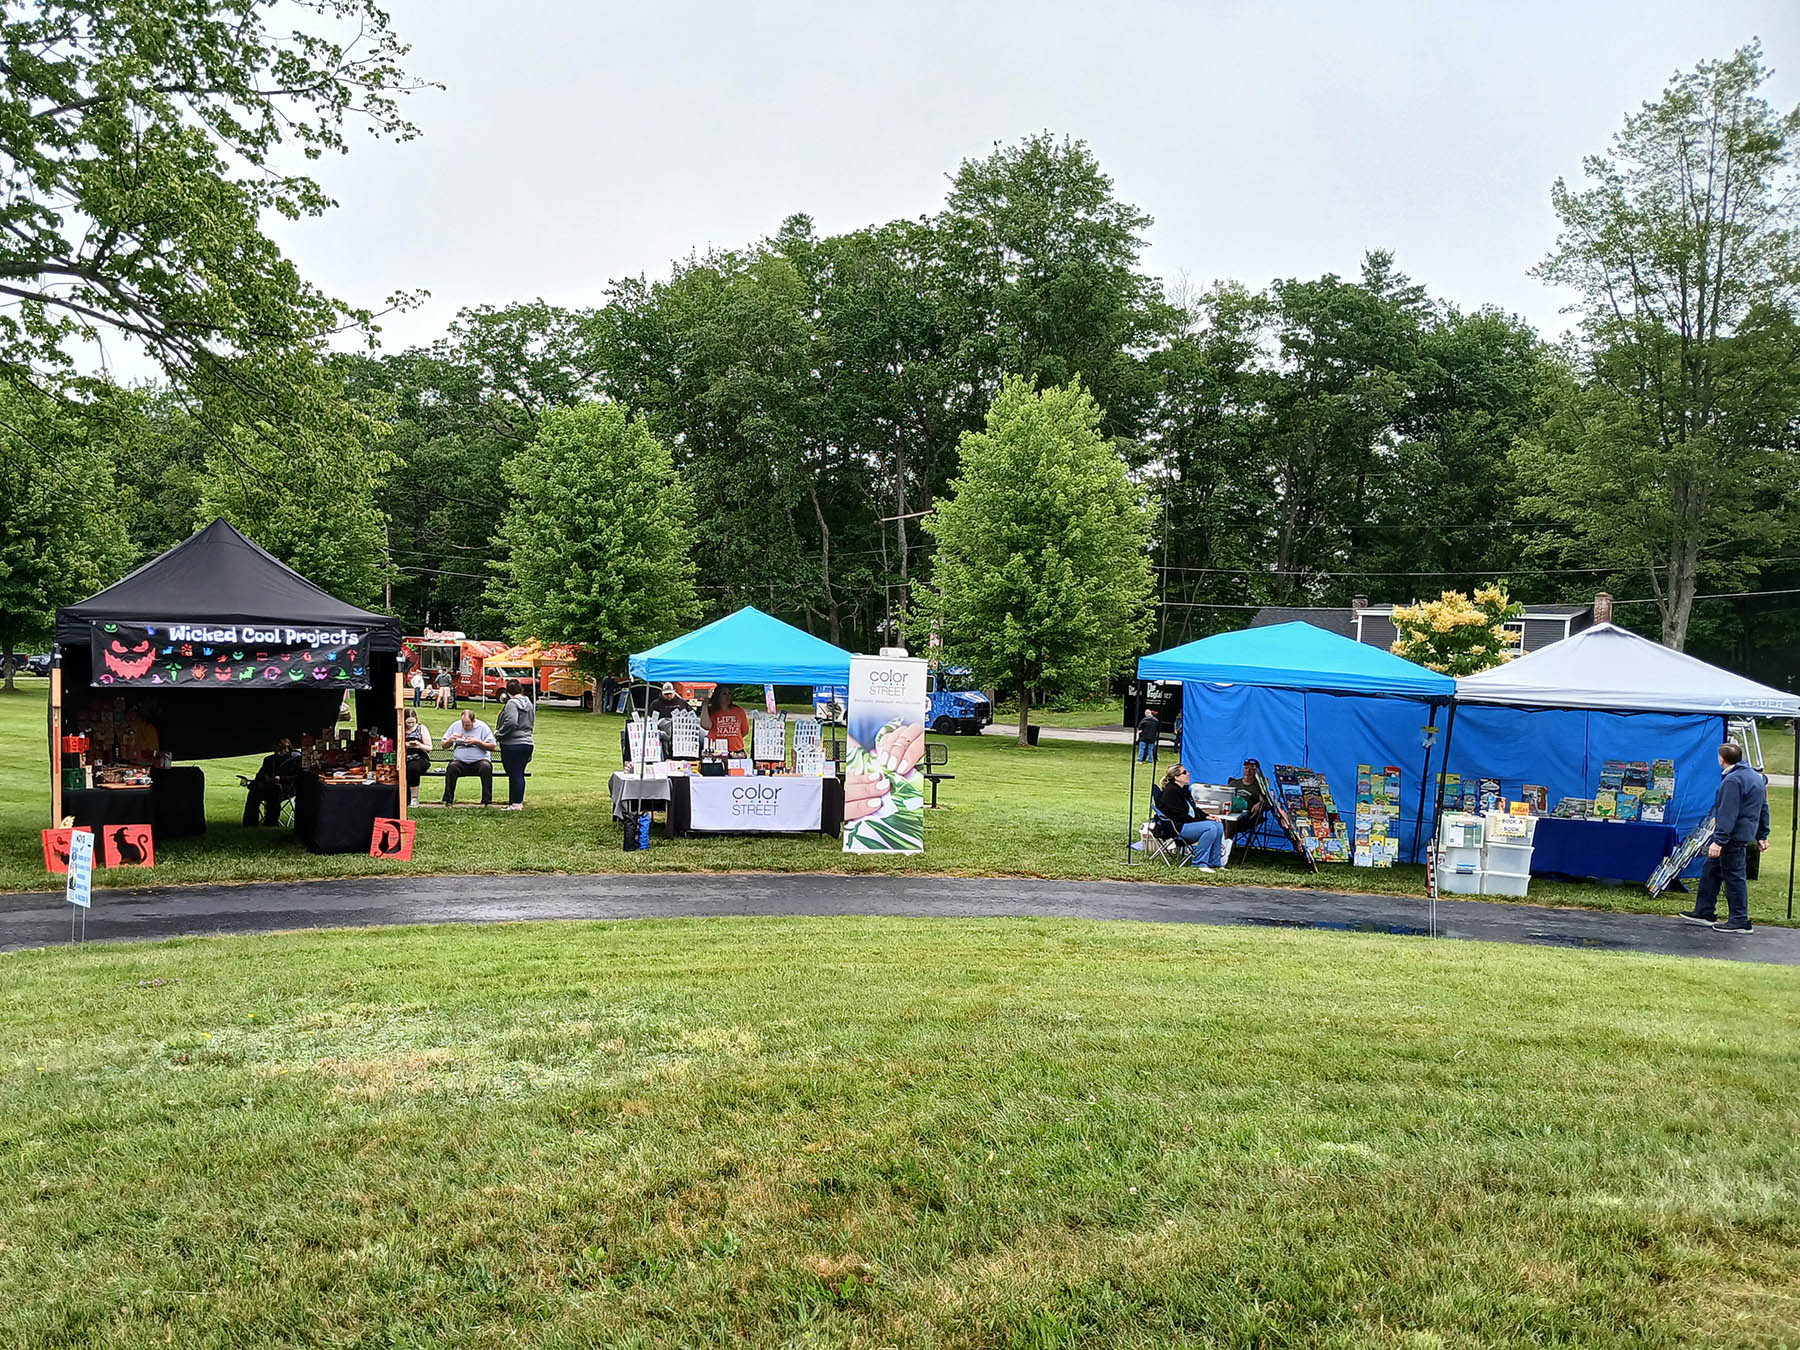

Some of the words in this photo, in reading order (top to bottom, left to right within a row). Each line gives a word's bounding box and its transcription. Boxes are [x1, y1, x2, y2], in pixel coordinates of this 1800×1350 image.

[168, 626, 237, 642] Wicked
[241, 627, 281, 643] Cool
[284, 628, 360, 648] Projects
[869, 669, 909, 683] color
[869, 686, 906, 697] STREET
[1737, 698, 1784, 708] LEADER
[716, 715, 737, 723] LIFE
[731, 783, 783, 800] color
[731, 804, 779, 816] STREET
